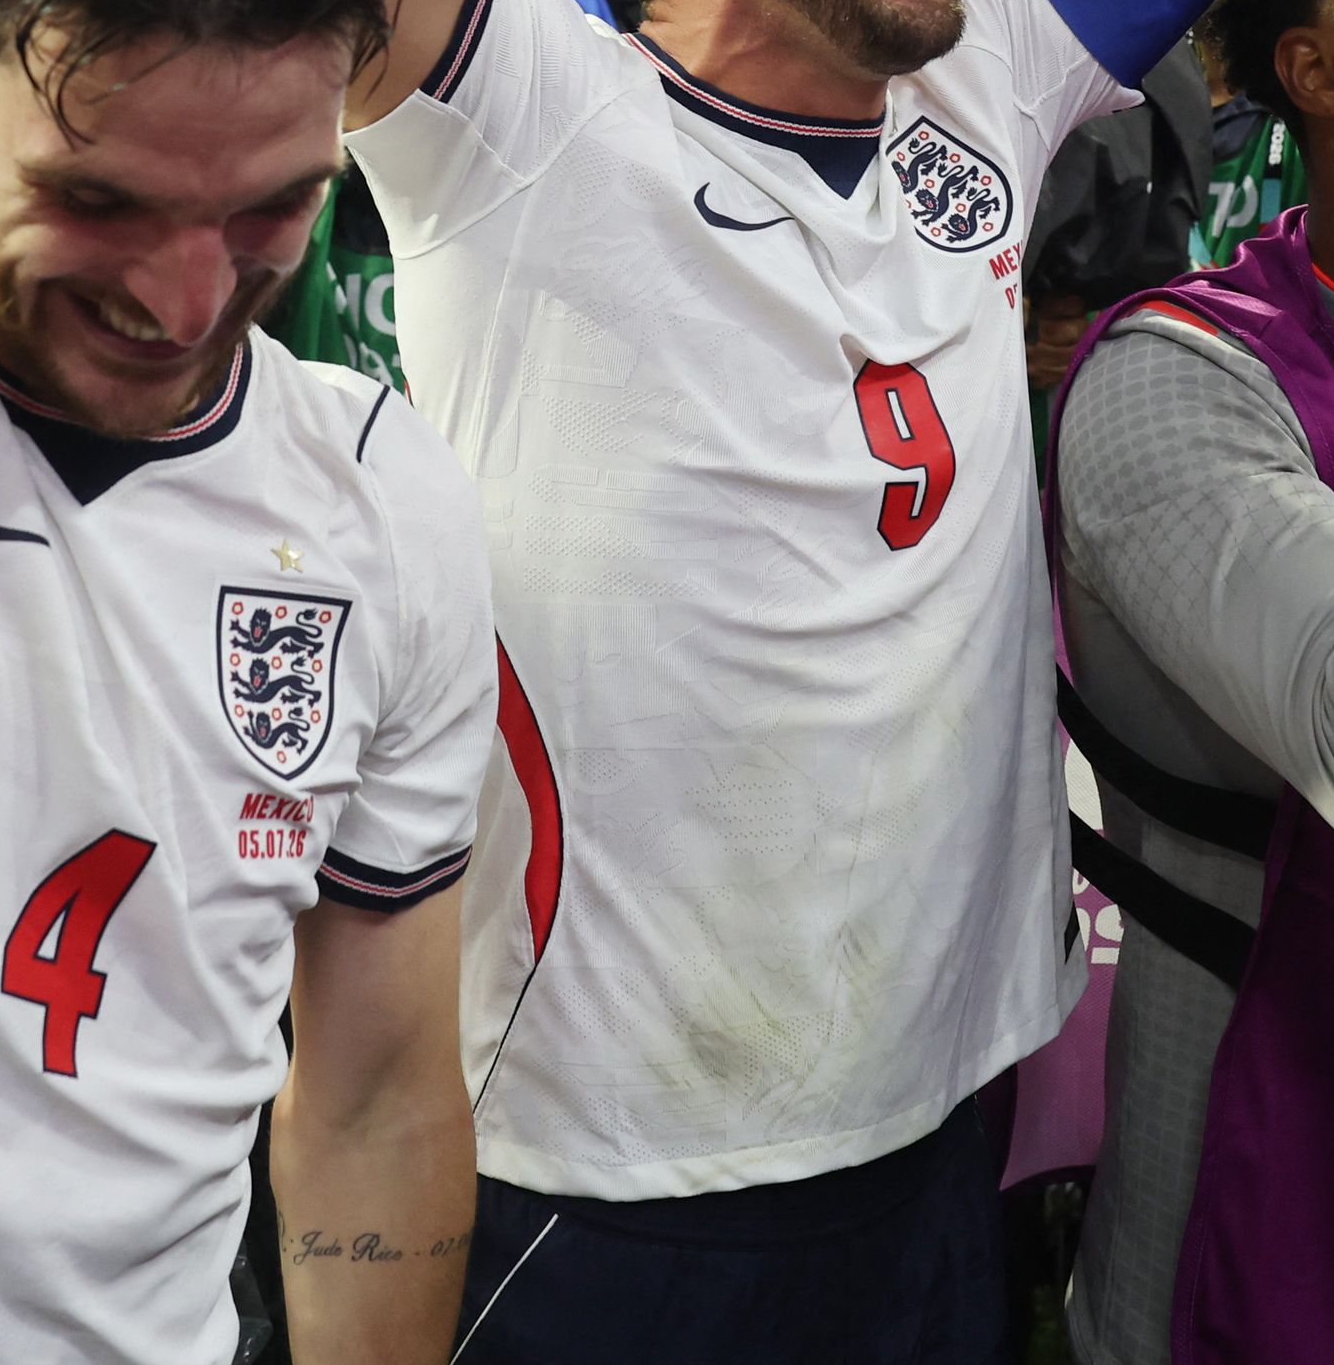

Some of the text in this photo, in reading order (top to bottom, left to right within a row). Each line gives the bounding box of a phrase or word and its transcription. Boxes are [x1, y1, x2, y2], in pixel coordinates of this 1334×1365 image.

[853, 358, 956, 551] 9
[239, 793, 314, 823] MEXICO
[238, 828, 307, 859] 05.07.26
[1, 827, 158, 1078] 4
[293, 1231, 343, 1266] Jude
[351, 1232, 403, 1263] Rice
